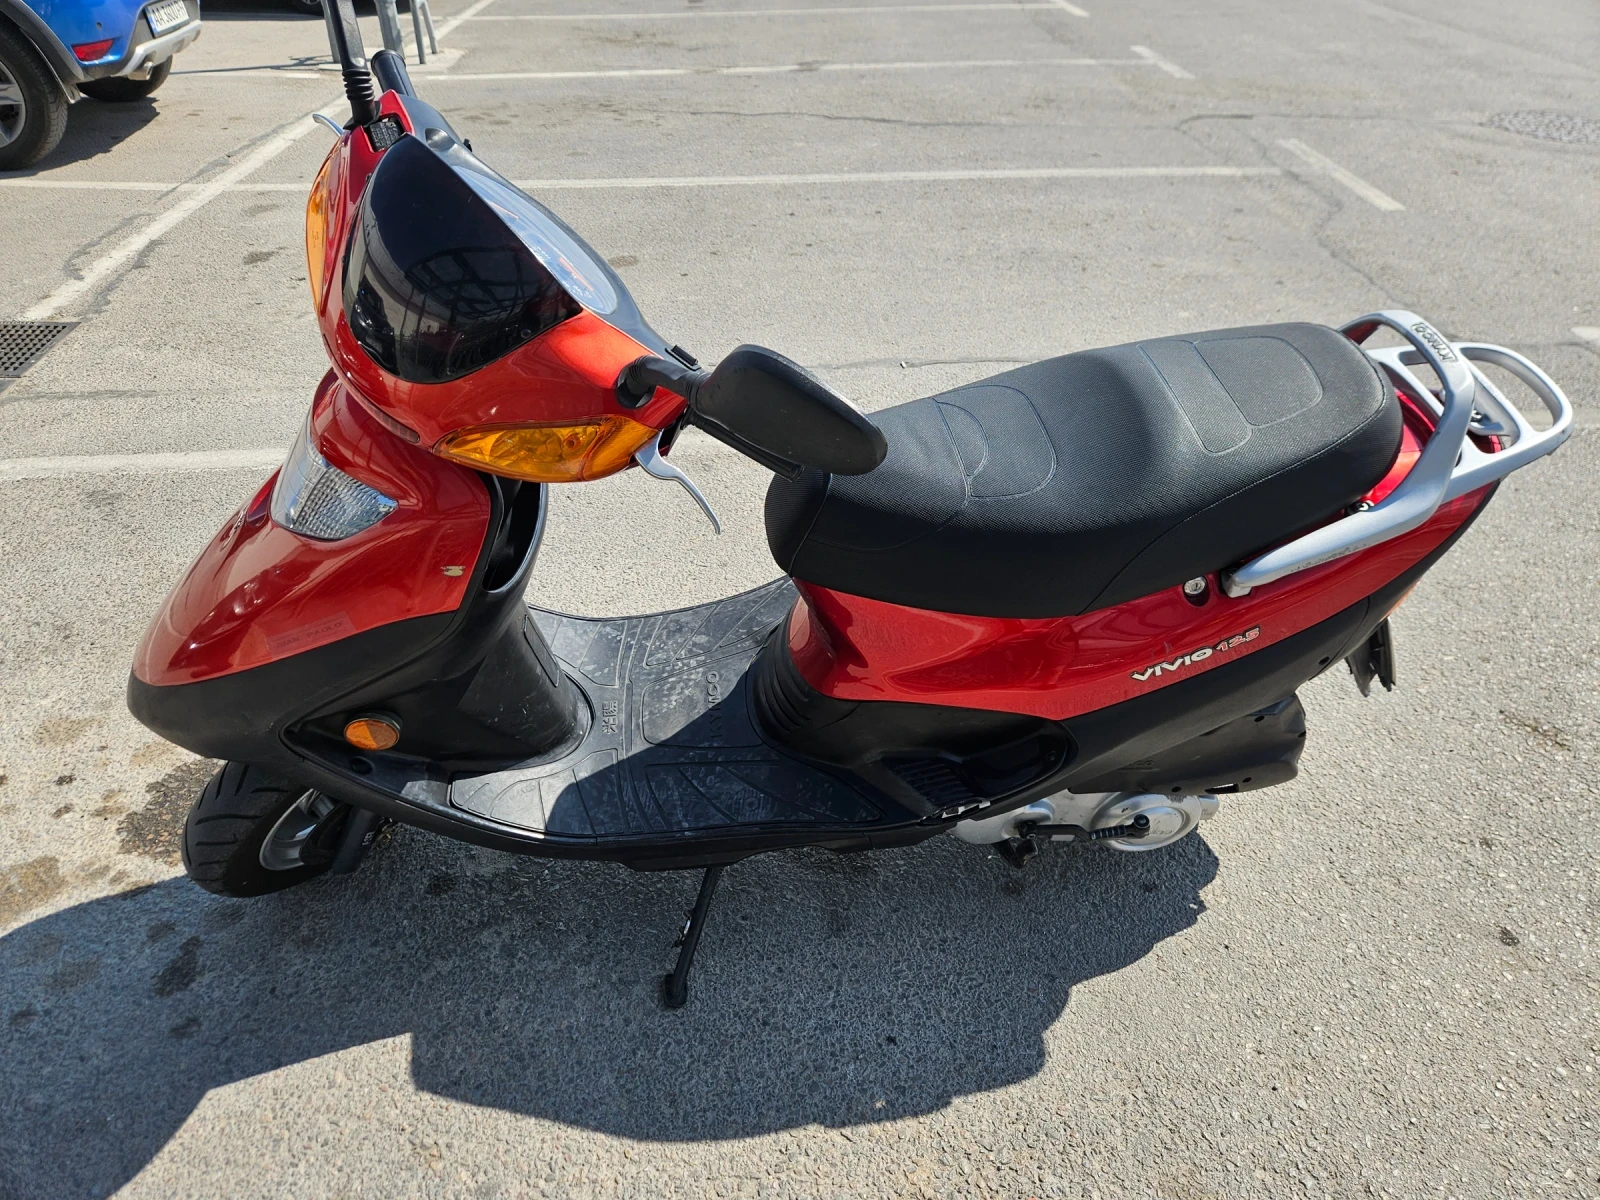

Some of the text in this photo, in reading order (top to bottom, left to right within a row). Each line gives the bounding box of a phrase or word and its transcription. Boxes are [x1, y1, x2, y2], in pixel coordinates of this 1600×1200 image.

[1131, 625, 1261, 681] VIVIO 125
[705, 671, 723, 738] KYMCO
